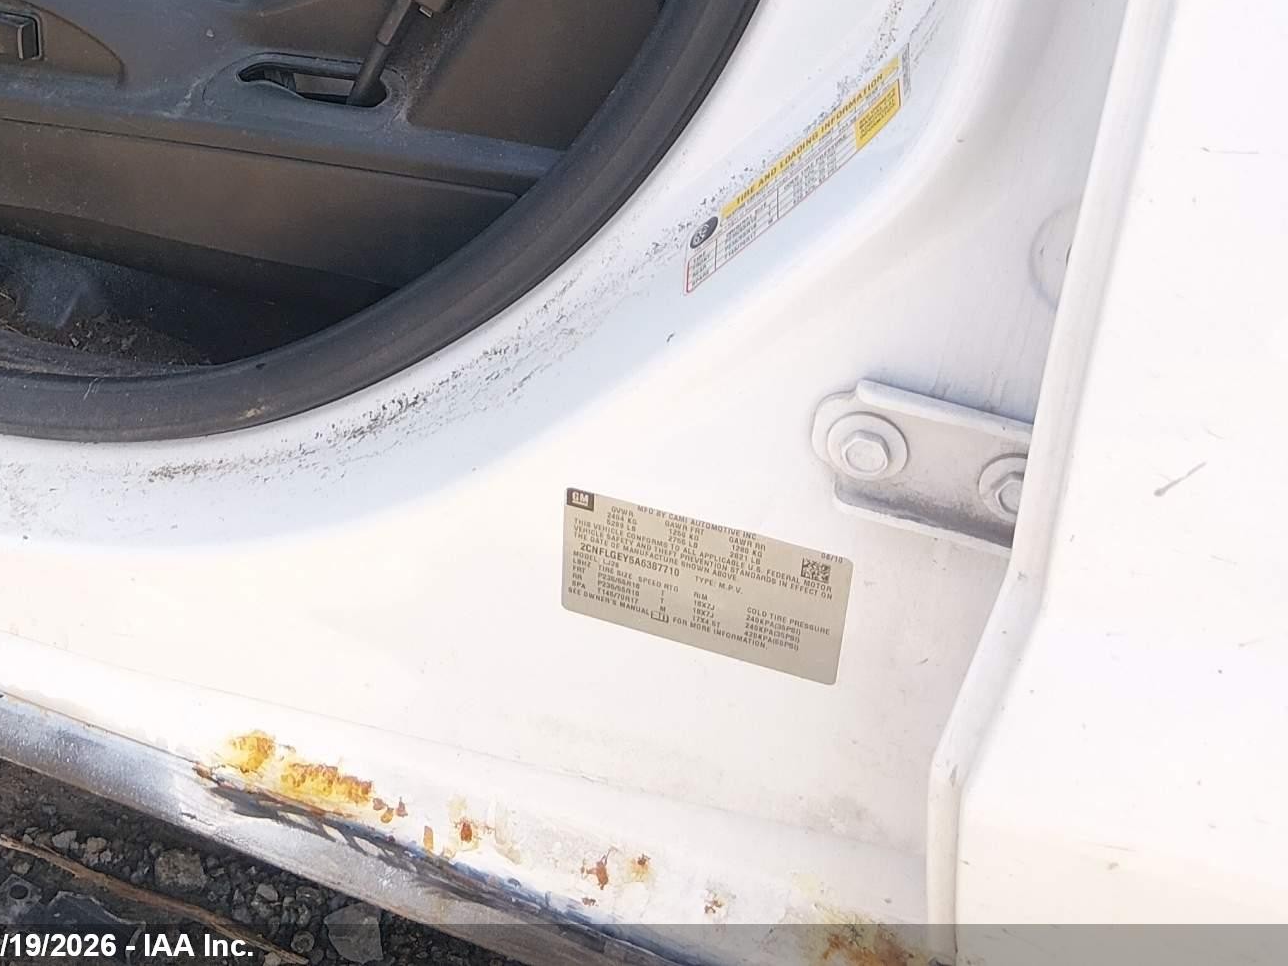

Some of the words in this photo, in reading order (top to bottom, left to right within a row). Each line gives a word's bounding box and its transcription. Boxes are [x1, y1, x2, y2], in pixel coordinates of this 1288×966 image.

[736, 184, 755, 204] TIRE
[758, 167, 777, 188] AND
[779, 133, 819, 168] LOADING
[821, 74, 884, 132] INFORMATION
[572, 490, 589, 505] GM
[627, 524, 636, 532] LB
[628, 517, 637, 525] KG
[669, 513, 687, 524] CAMI
[691, 518, 740, 537] AUTOMOTIVE
[689, 533, 699, 541] KG
[690, 526, 704, 536] FRT
[689, 541, 698, 549] LB
[574, 532, 587, 541] THE
[591, 536, 608, 547] DATE
[611, 542, 619, 550] OF
[623, 545, 678, 565] MANUFACTURE
[681, 560, 710, 574] SHOWN
[575, 518, 591, 528] THIS
[594, 523, 623, 536] VEHICLE
[627, 532, 668, 548] CONFORMS
[671, 544, 680, 552] TO
[683, 547, 696, 556] ALL
[699, 551, 745, 569] APPLICABLE
[766, 569, 800, 584] FEDERAL
[804, 579, 832, 593] MOTOR
[753, 550, 763, 558] KG
[574, 525, 605, 539] VEHICLE
[607, 534, 634, 546] SAFETY
[636, 541, 652, 551] AND
[655, 546, 677, 558] THEFT
[680, 553, 727, 572] PREVENTION
[730, 567, 777, 585] STANDARDS
[779, 580, 787, 588] IN
[790, 583, 818, 596] EFFECT
[821, 591, 833, 600] ON
[751, 557, 761, 565] LB
[568, 586, 581, 596] SEE
[620, 601, 650, 615] MANUAL
[673, 616, 688, 626] FOR
[690, 621, 710, 633] MORE
[747, 606, 767, 618] COLD
[770, 613, 787, 624] TIRE
[789, 618, 831, 636] PRESSURE
